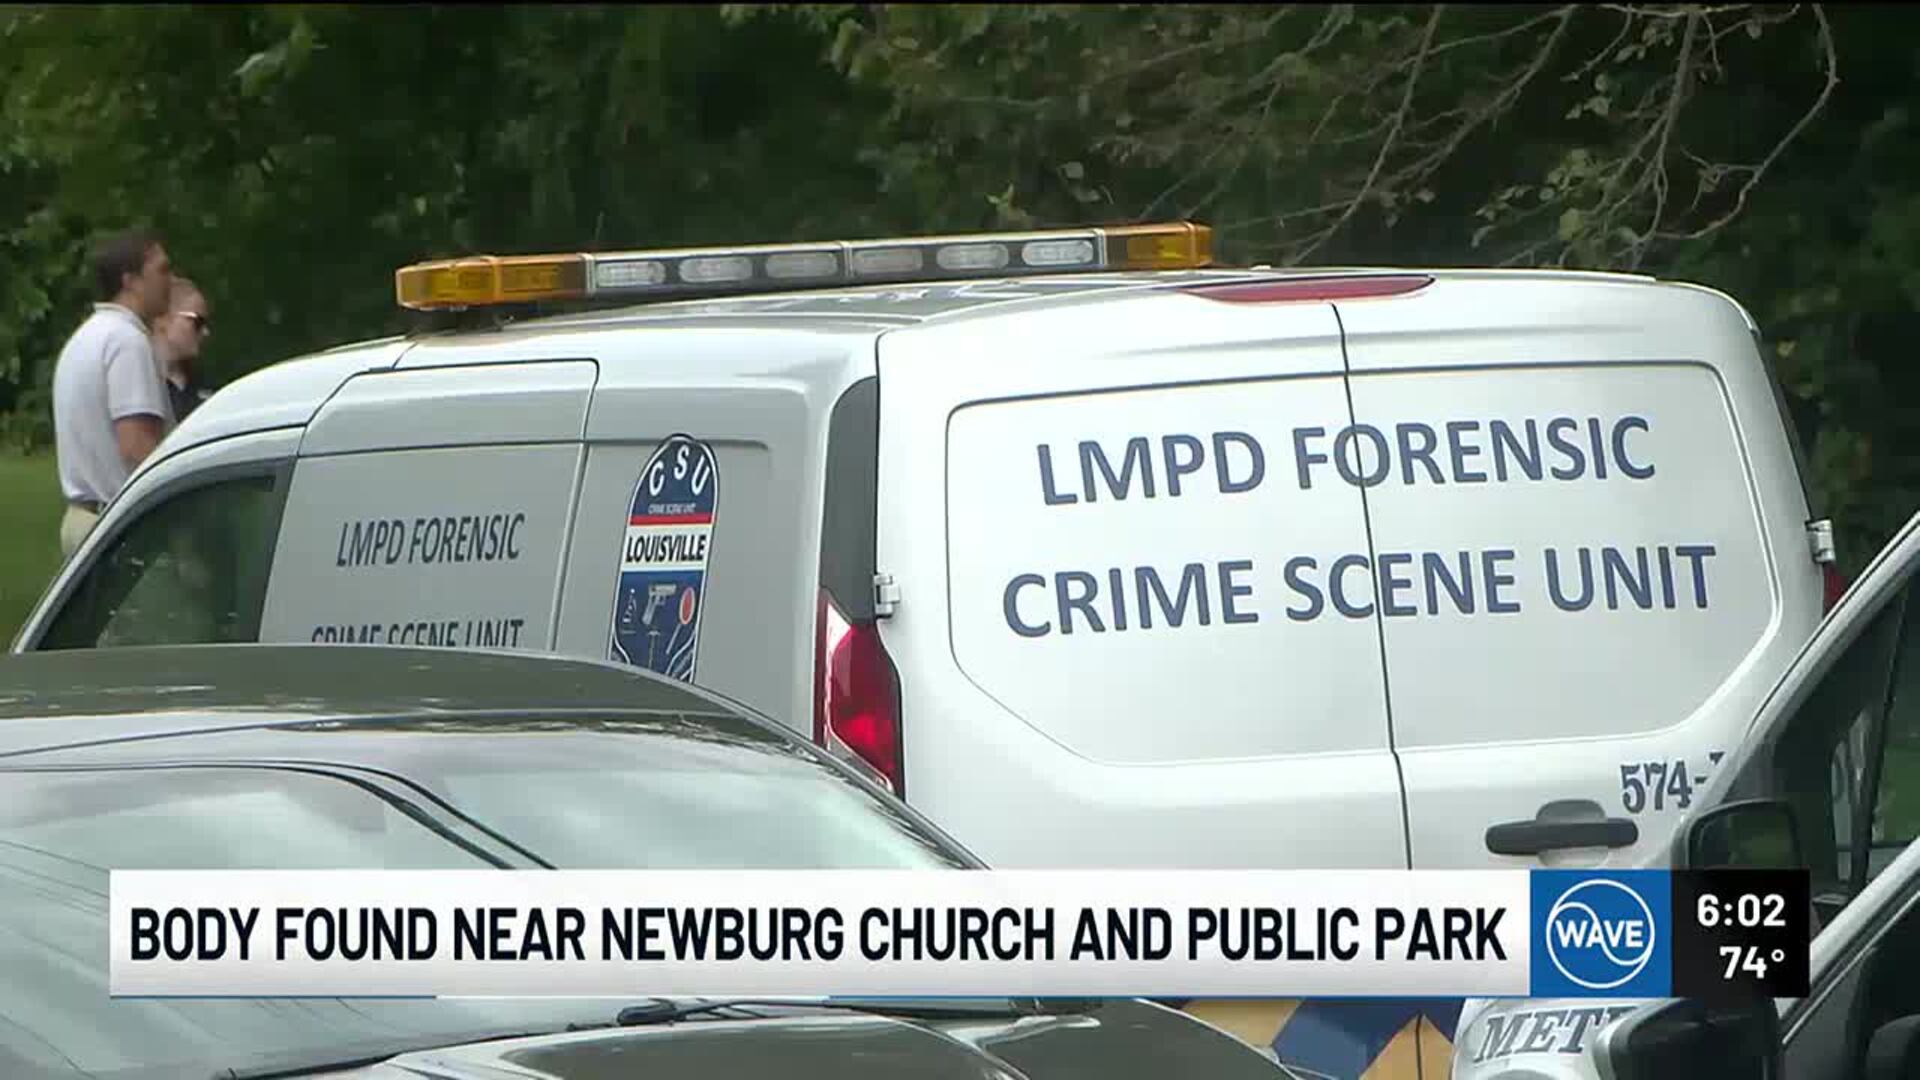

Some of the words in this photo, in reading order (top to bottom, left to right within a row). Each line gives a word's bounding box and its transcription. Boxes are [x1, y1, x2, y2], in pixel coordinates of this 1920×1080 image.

[649, 445, 710, 496] CSU
[1037, 431, 1265, 505] LMPD
[1293, 416, 1655, 488] FORENSIC
[336, 520, 405, 567] LMPD
[408, 512, 525, 564] FORENSIC
[625, 534, 706, 562] LOUISVILLE
[1003, 560, 1259, 637] CRIME
[1284, 549, 1521, 621] SCENE
[1544, 545, 1716, 611] UNIT
[1620, 751, 1725, 814] 574-
